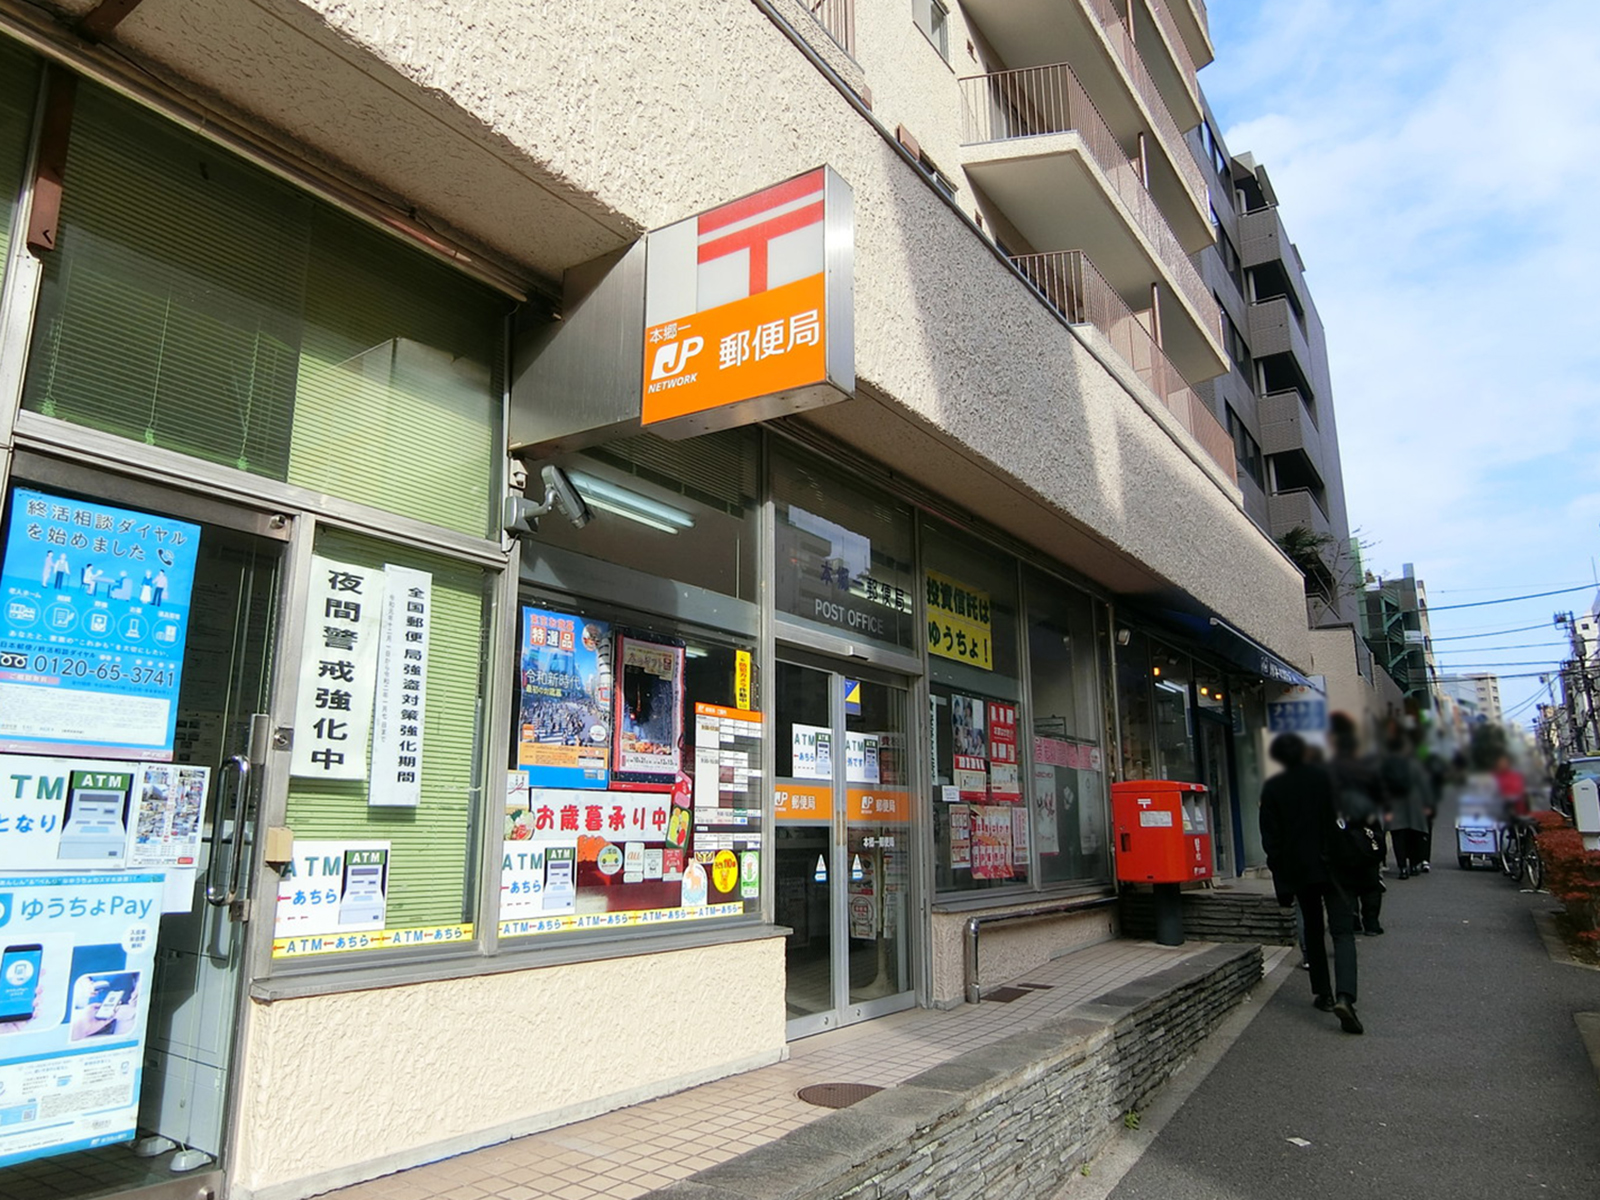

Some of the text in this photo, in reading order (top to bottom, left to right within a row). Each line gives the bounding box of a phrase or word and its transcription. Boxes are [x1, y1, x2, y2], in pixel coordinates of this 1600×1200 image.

[649, 323, 692, 344] 本郷一
[719, 309, 820, 370] 郵便局
[650, 336, 704, 381] JP
[647, 373, 698, 394] NETWORK
[27, 500, 187, 546] 終活相談ダイヤル
[27, 523, 146, 561] を始めました
[926, 575, 990, 625] 投資信託は
[815, 598, 884, 635] POST OFFICE
[531, 626, 573, 650] 特選品
[34, 655, 175, 687] 0120-65-3741
[310, 569, 364, 771] 夜間警戒強化中
[526, 668, 581, 690] 令和新時代
[397, 587, 425, 784] 全国郵便局強盗対策強化期間
[794, 733, 815, 746] ATM
[799, 752, 815, 762] あちら
[81, 774, 123, 788] ATM
[791, 795, 816, 810] 郵便局
[876, 799, 895, 813] 郵便局
[536, 804, 667, 831] お歳暮承り中
[352, 853, 380, 863] ATM
[502, 853, 543, 870] ATM
[551, 849, 570, 859] ATM
[292, 888, 337, 905] あちら
[510, 880, 541, 894] あちら
[21, 896, 153, 921] ゆうちょPay
[503, 904, 738, 935] ATM あちら ATM あちら ATM あちら ATM あちら
[286, 927, 462, 953] ATM あちら ATM あちら
